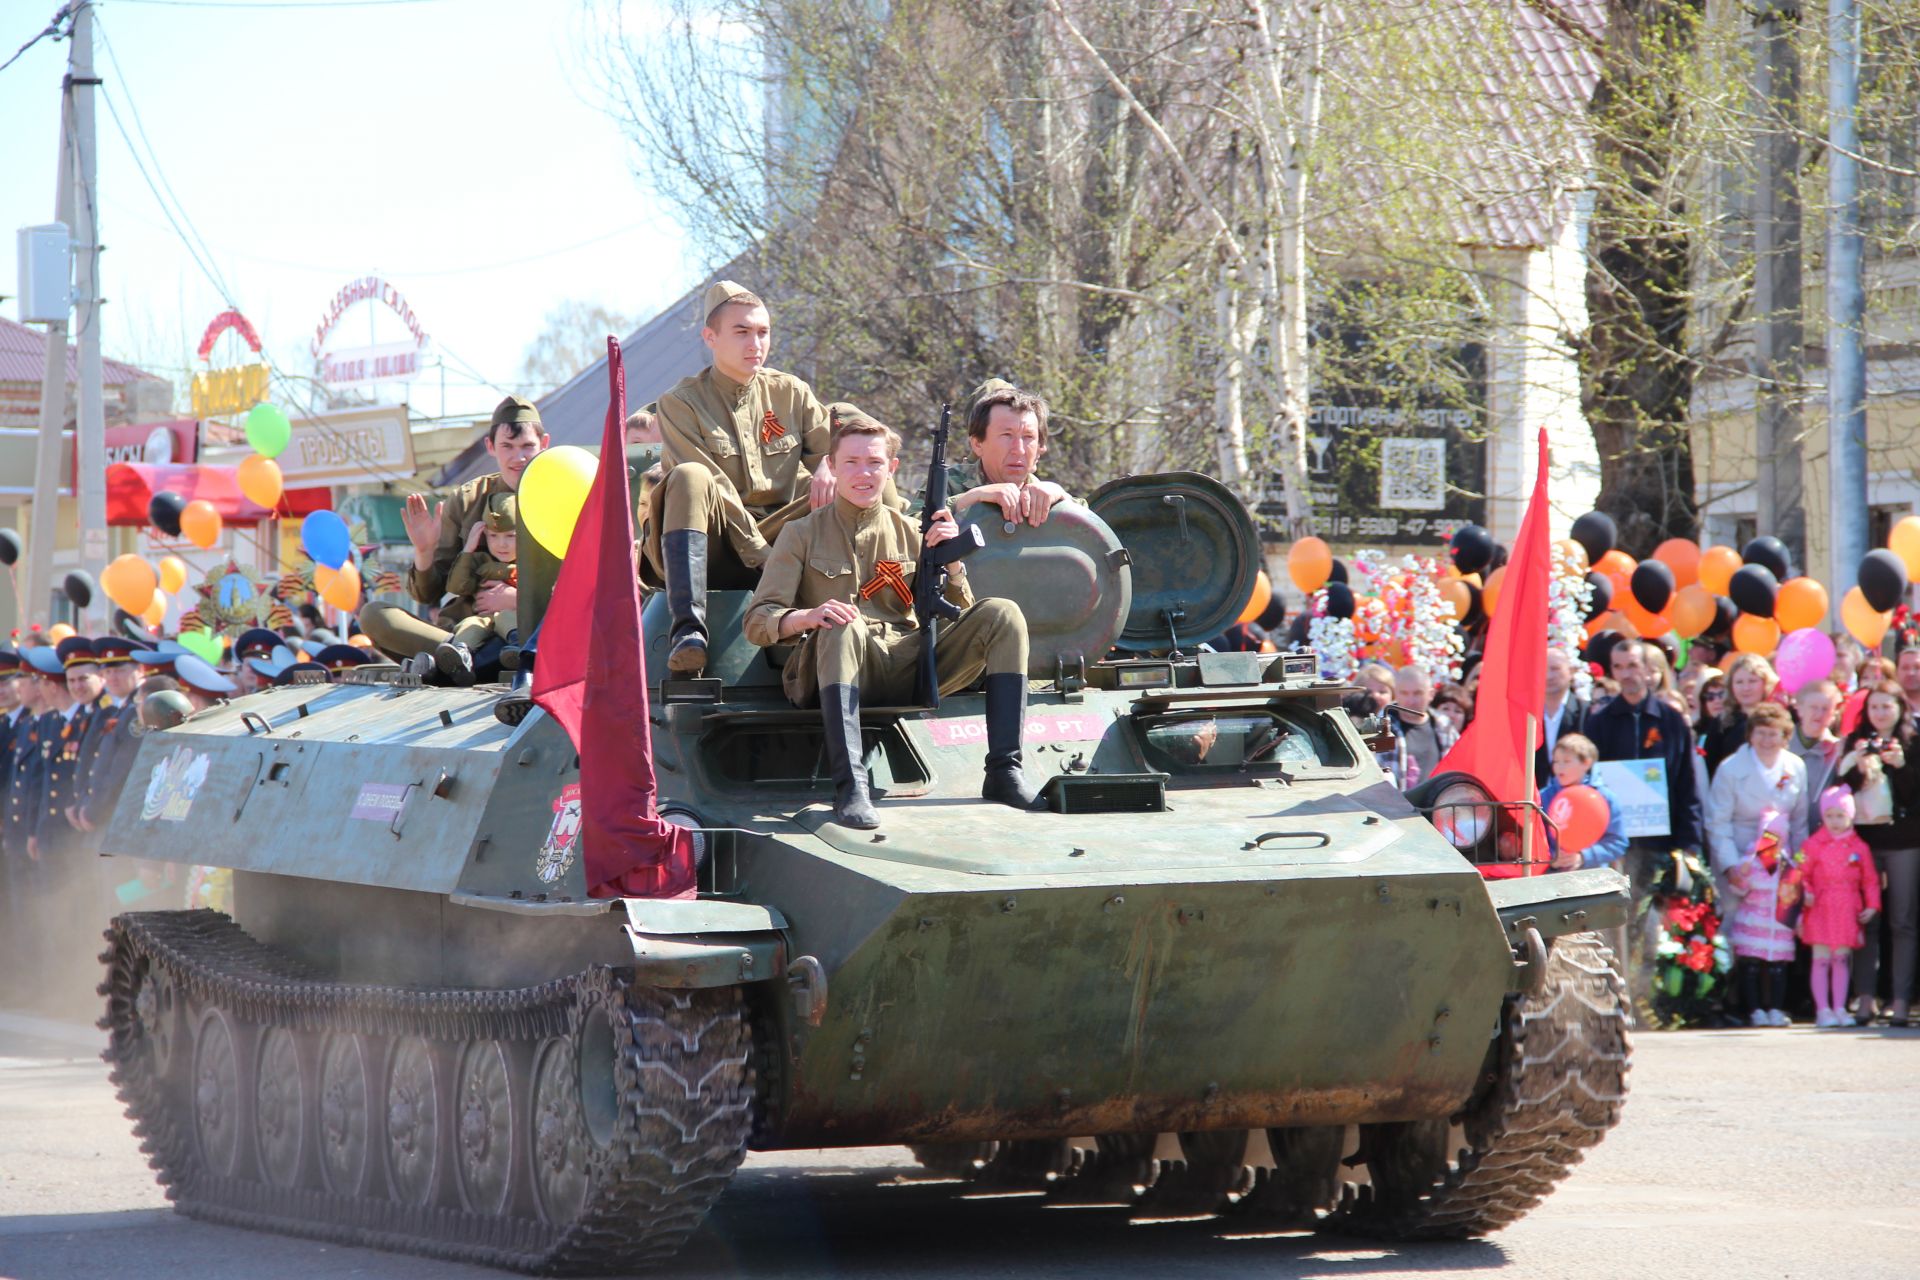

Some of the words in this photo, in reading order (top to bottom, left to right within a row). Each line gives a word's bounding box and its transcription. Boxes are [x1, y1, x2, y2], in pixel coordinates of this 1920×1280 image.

[382, 282, 426, 349] САЛОН
[298, 426, 386, 466] ПРОДУКТЫ
[1056, 720, 1084, 735] РТ
